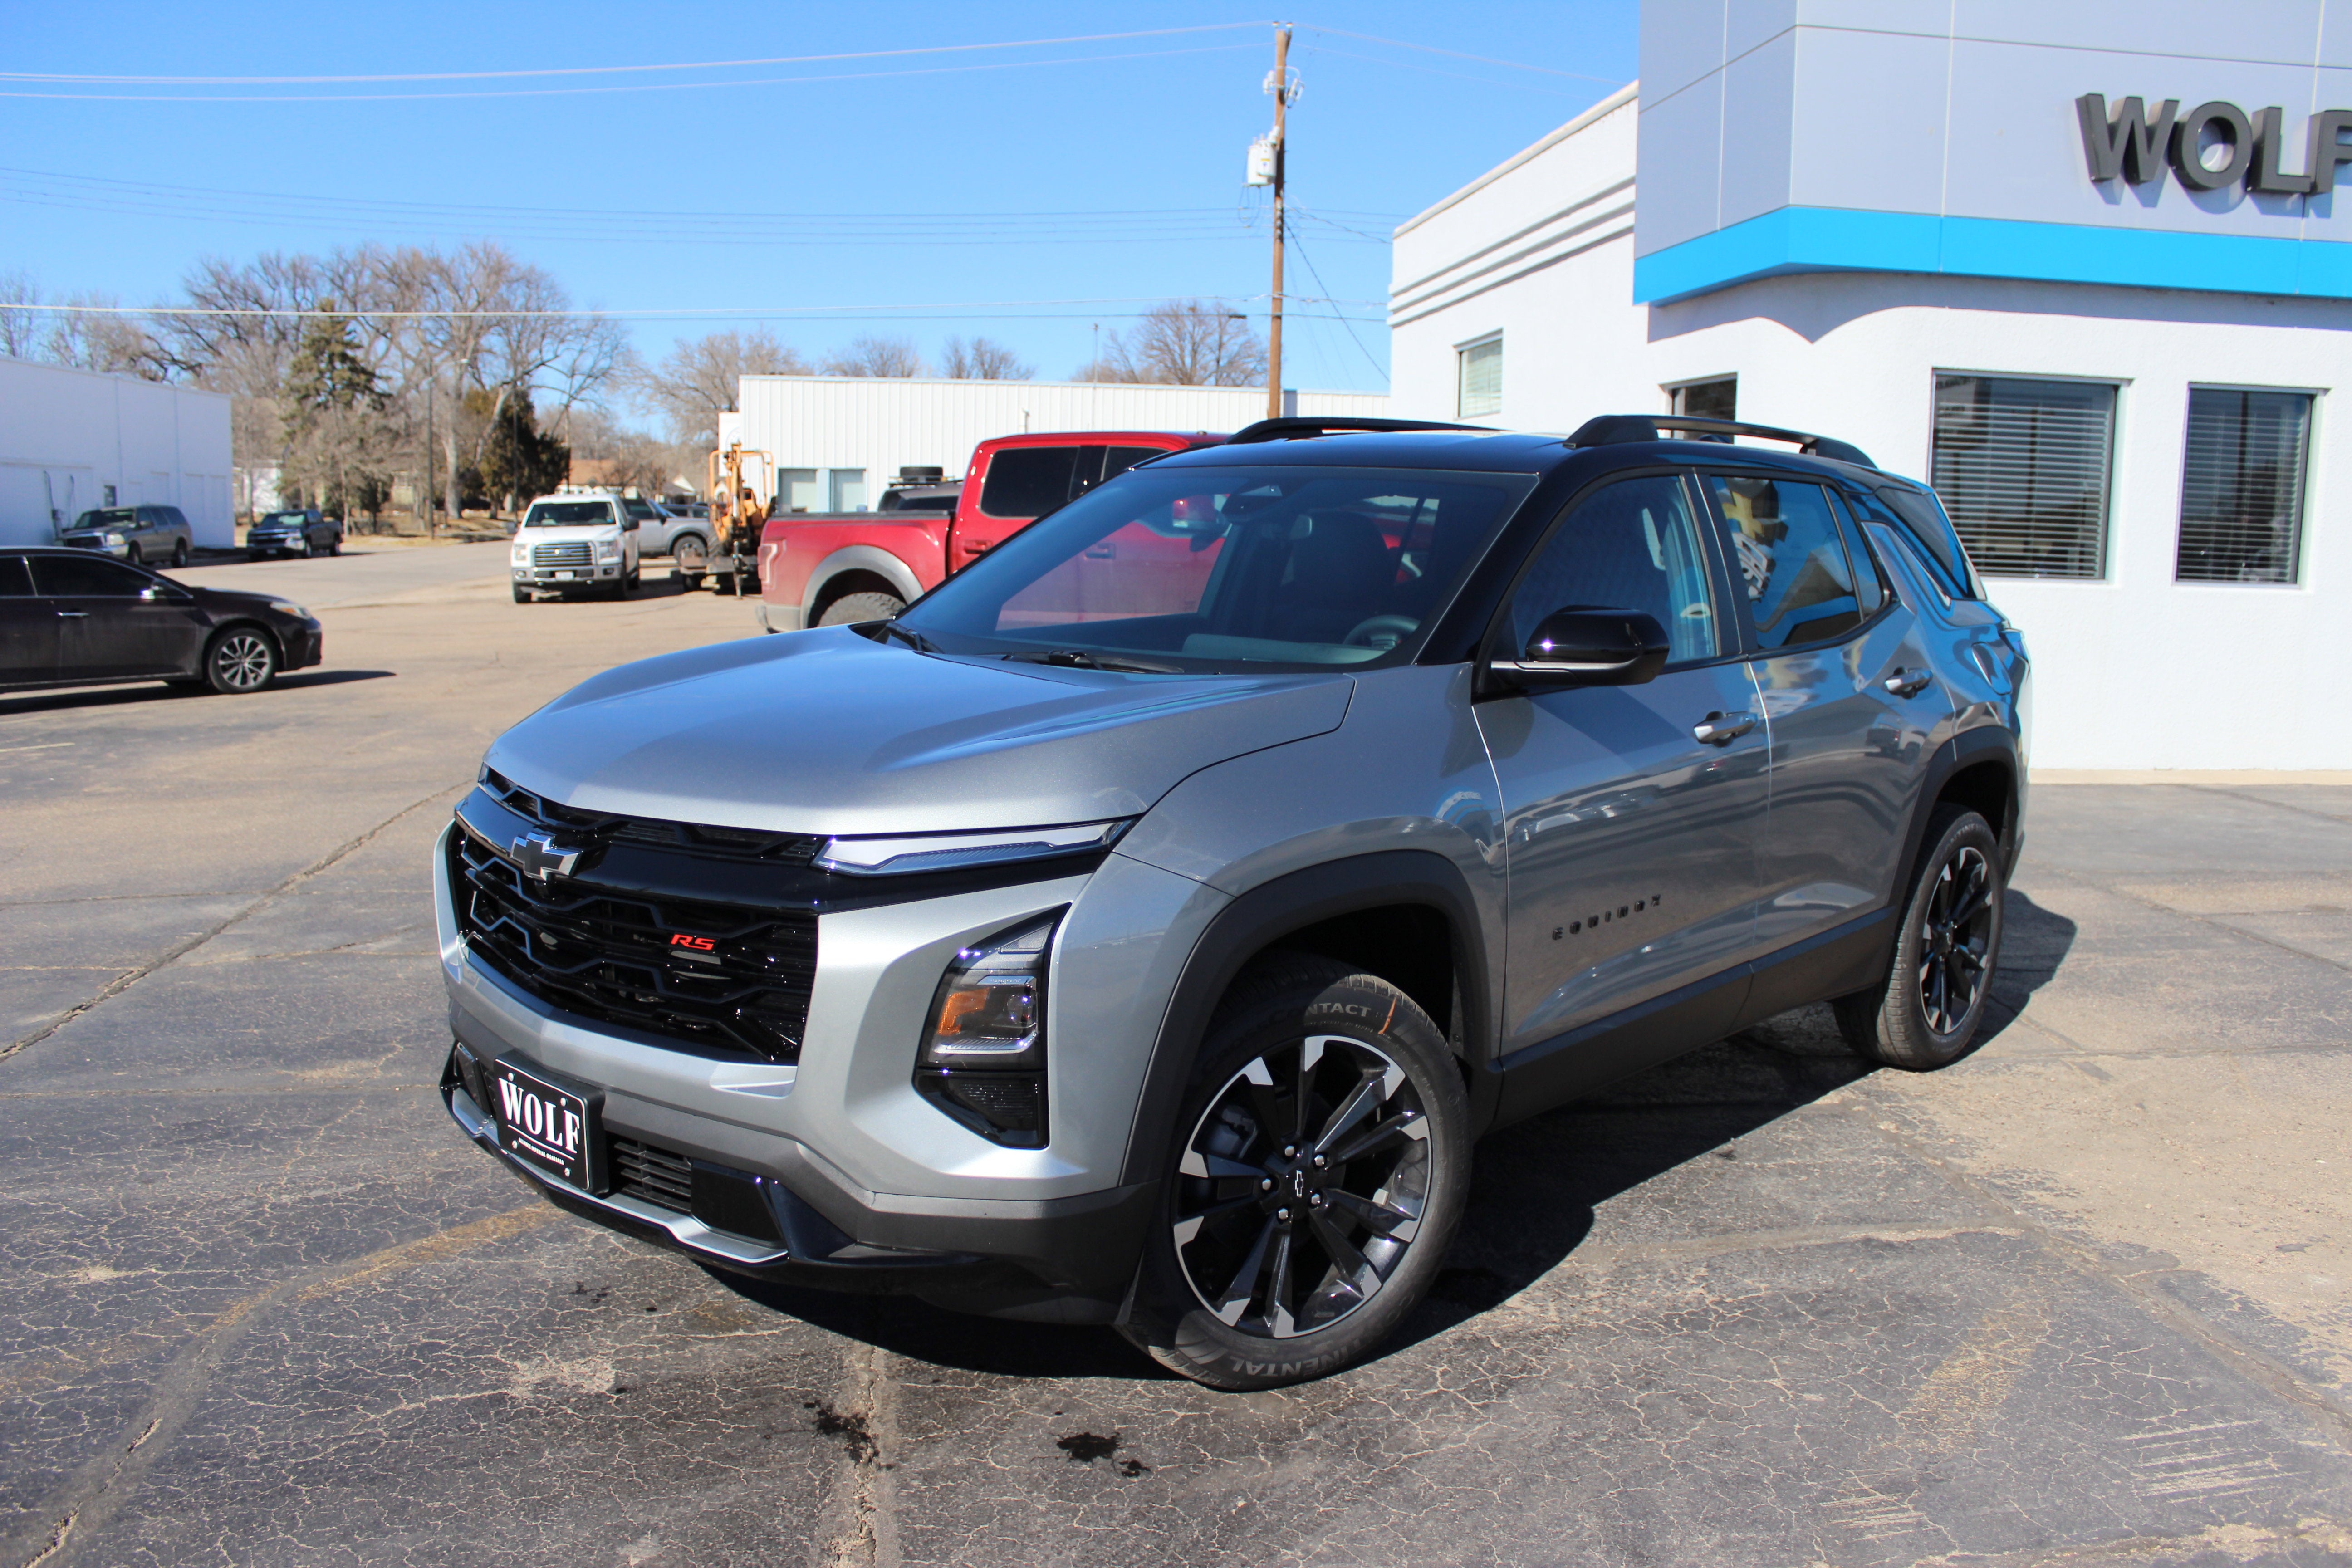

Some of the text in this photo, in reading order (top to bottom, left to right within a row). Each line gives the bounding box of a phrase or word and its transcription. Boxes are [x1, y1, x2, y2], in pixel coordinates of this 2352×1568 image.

[2075, 93, 2352, 194] WOLF
[670, 934, 715, 951] RS
[499, 1078, 580, 1154] WOLF
